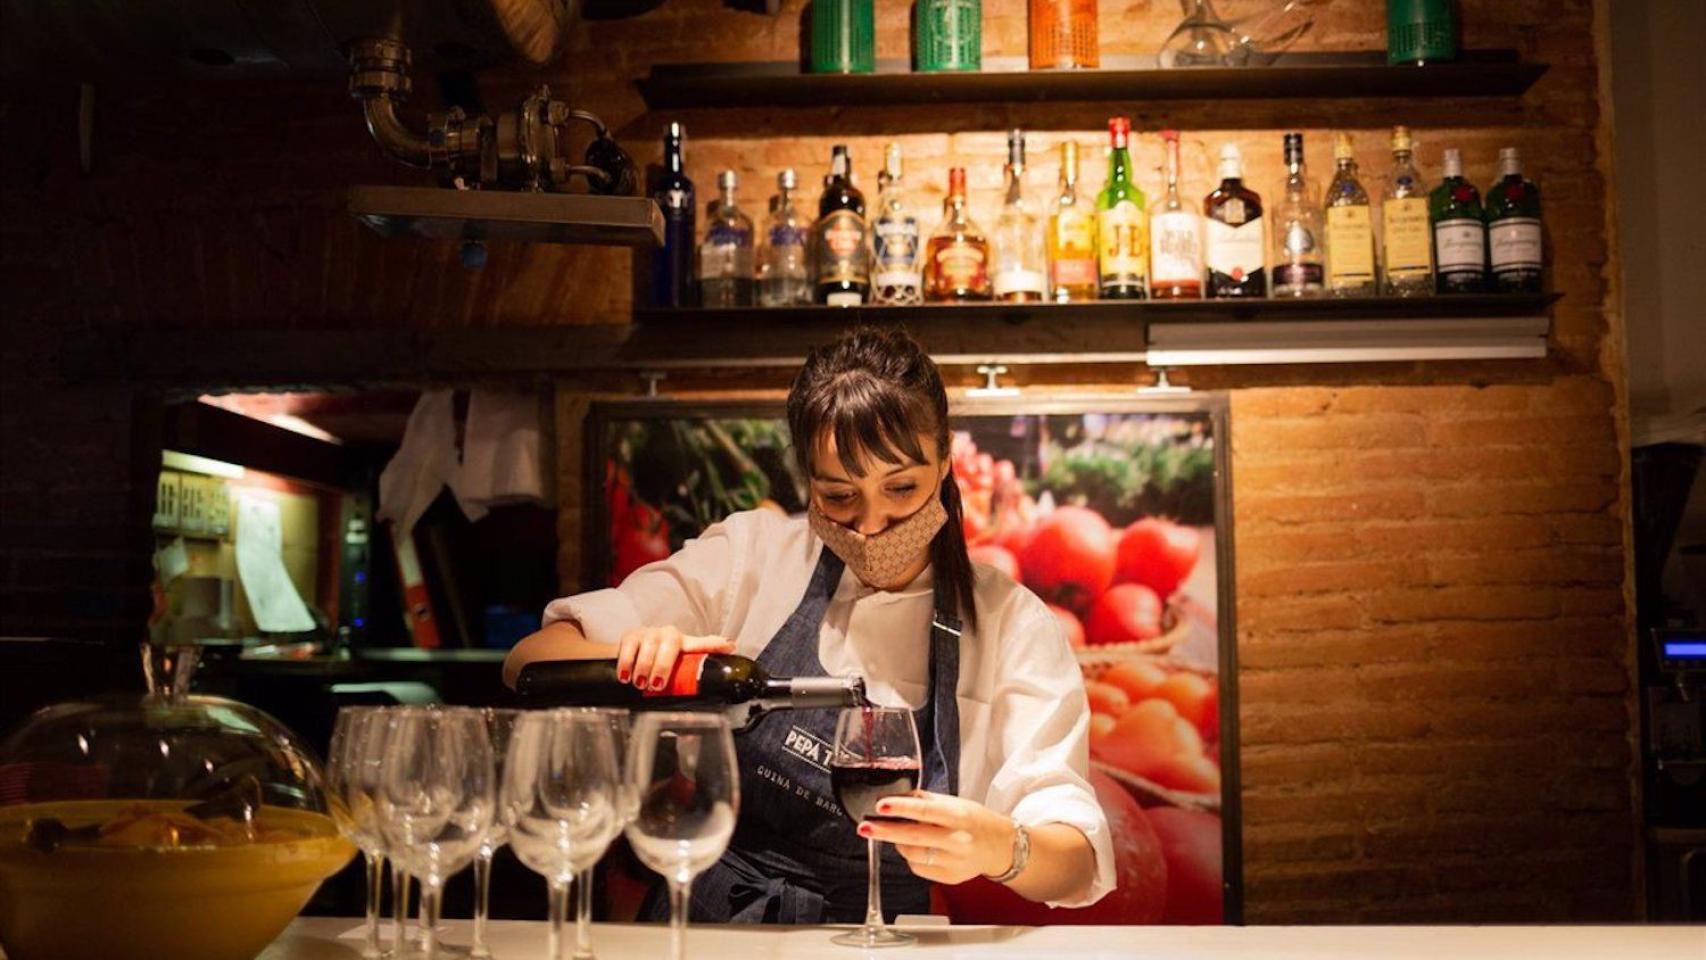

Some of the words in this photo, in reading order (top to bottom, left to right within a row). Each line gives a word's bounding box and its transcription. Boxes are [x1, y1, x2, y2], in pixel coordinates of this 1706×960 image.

[1108, 224, 1143, 257] JB
[785, 730, 820, 762] PEPA
[795, 786, 811, 800] DE
